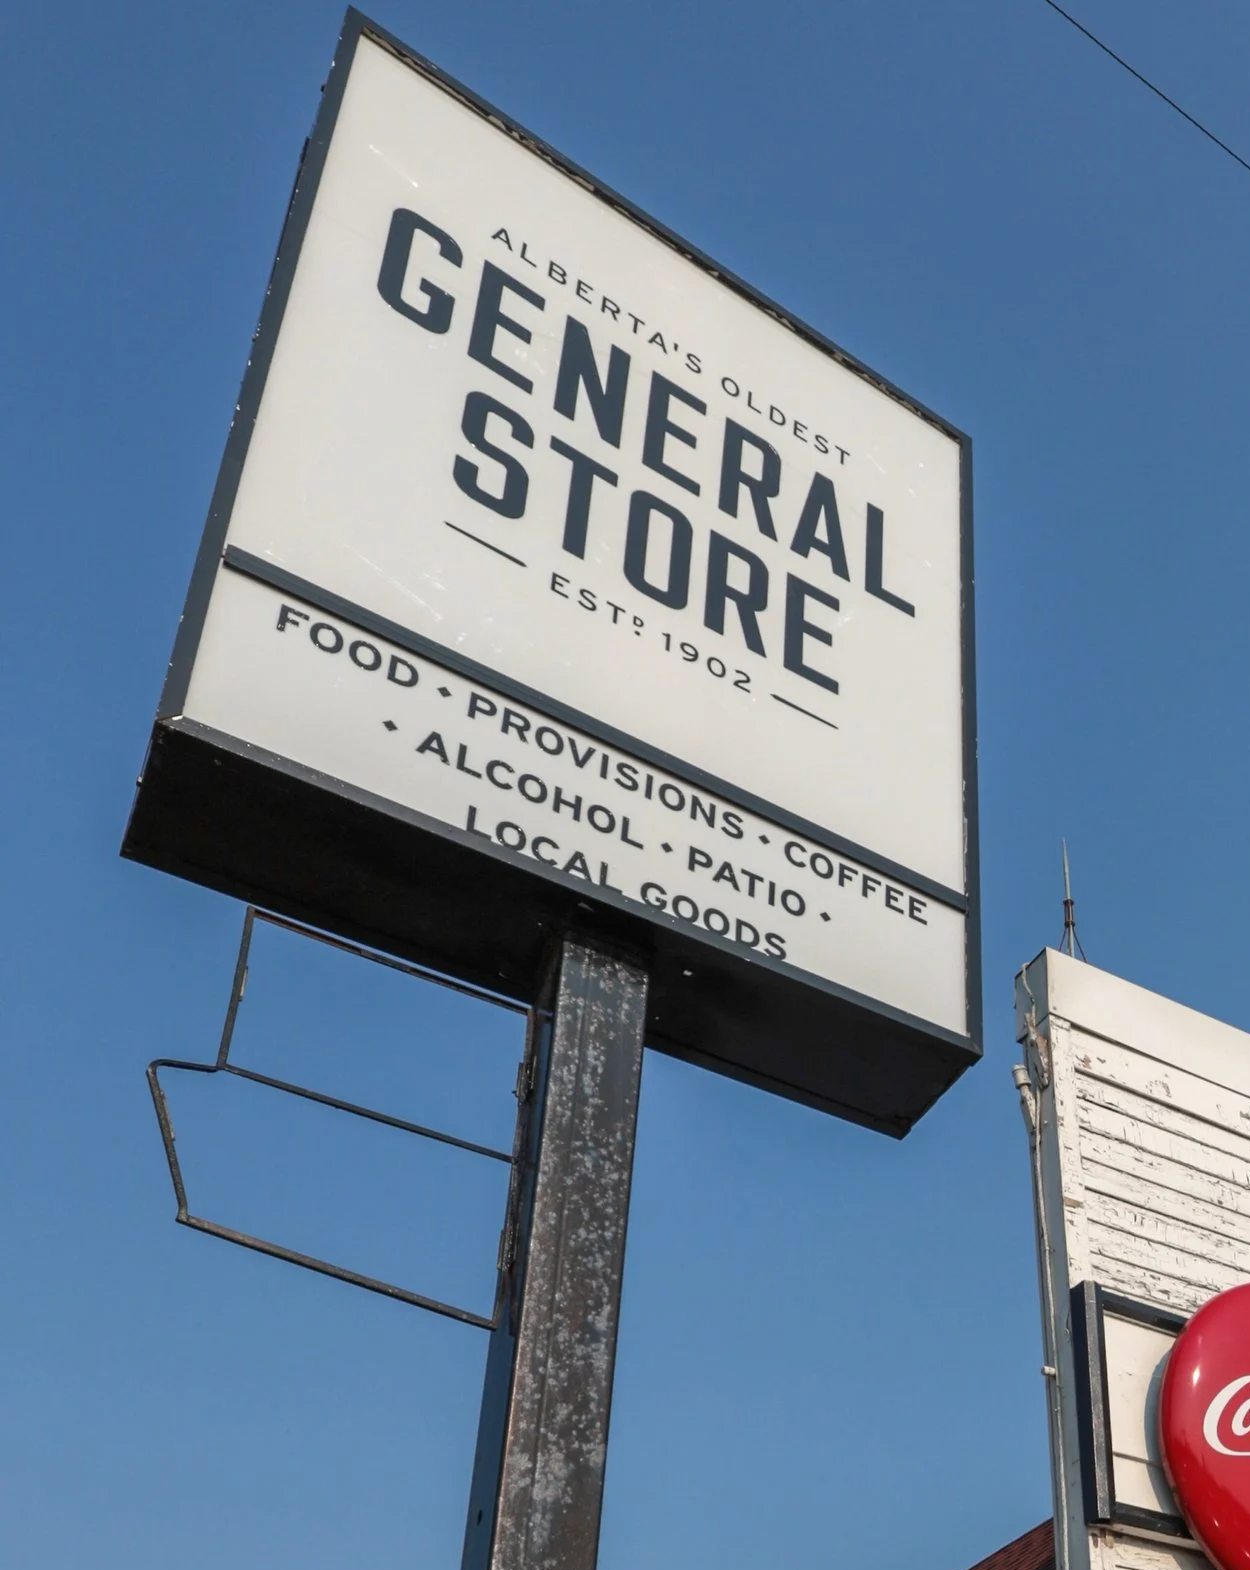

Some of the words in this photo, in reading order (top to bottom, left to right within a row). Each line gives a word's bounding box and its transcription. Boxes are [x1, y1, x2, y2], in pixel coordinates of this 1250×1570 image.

[377, 207, 916, 618] GENERAL
[491, 227, 701, 374] ALBERTA'S
[721, 376, 851, 466] OLDEST
[452, 390, 840, 696] STORE
[276, 604, 420, 688] FOOD
[467, 691, 745, 839] PROVISIONS
[784, 840, 928, 926] COFFEE
[662, 632, 752, 694] 1902
[414, 731, 645, 850] ALCOHOL
[687, 845, 807, 917] PATIO
[466, 805, 623, 888] LOCAL
[640, 882, 787, 961] GOODS
